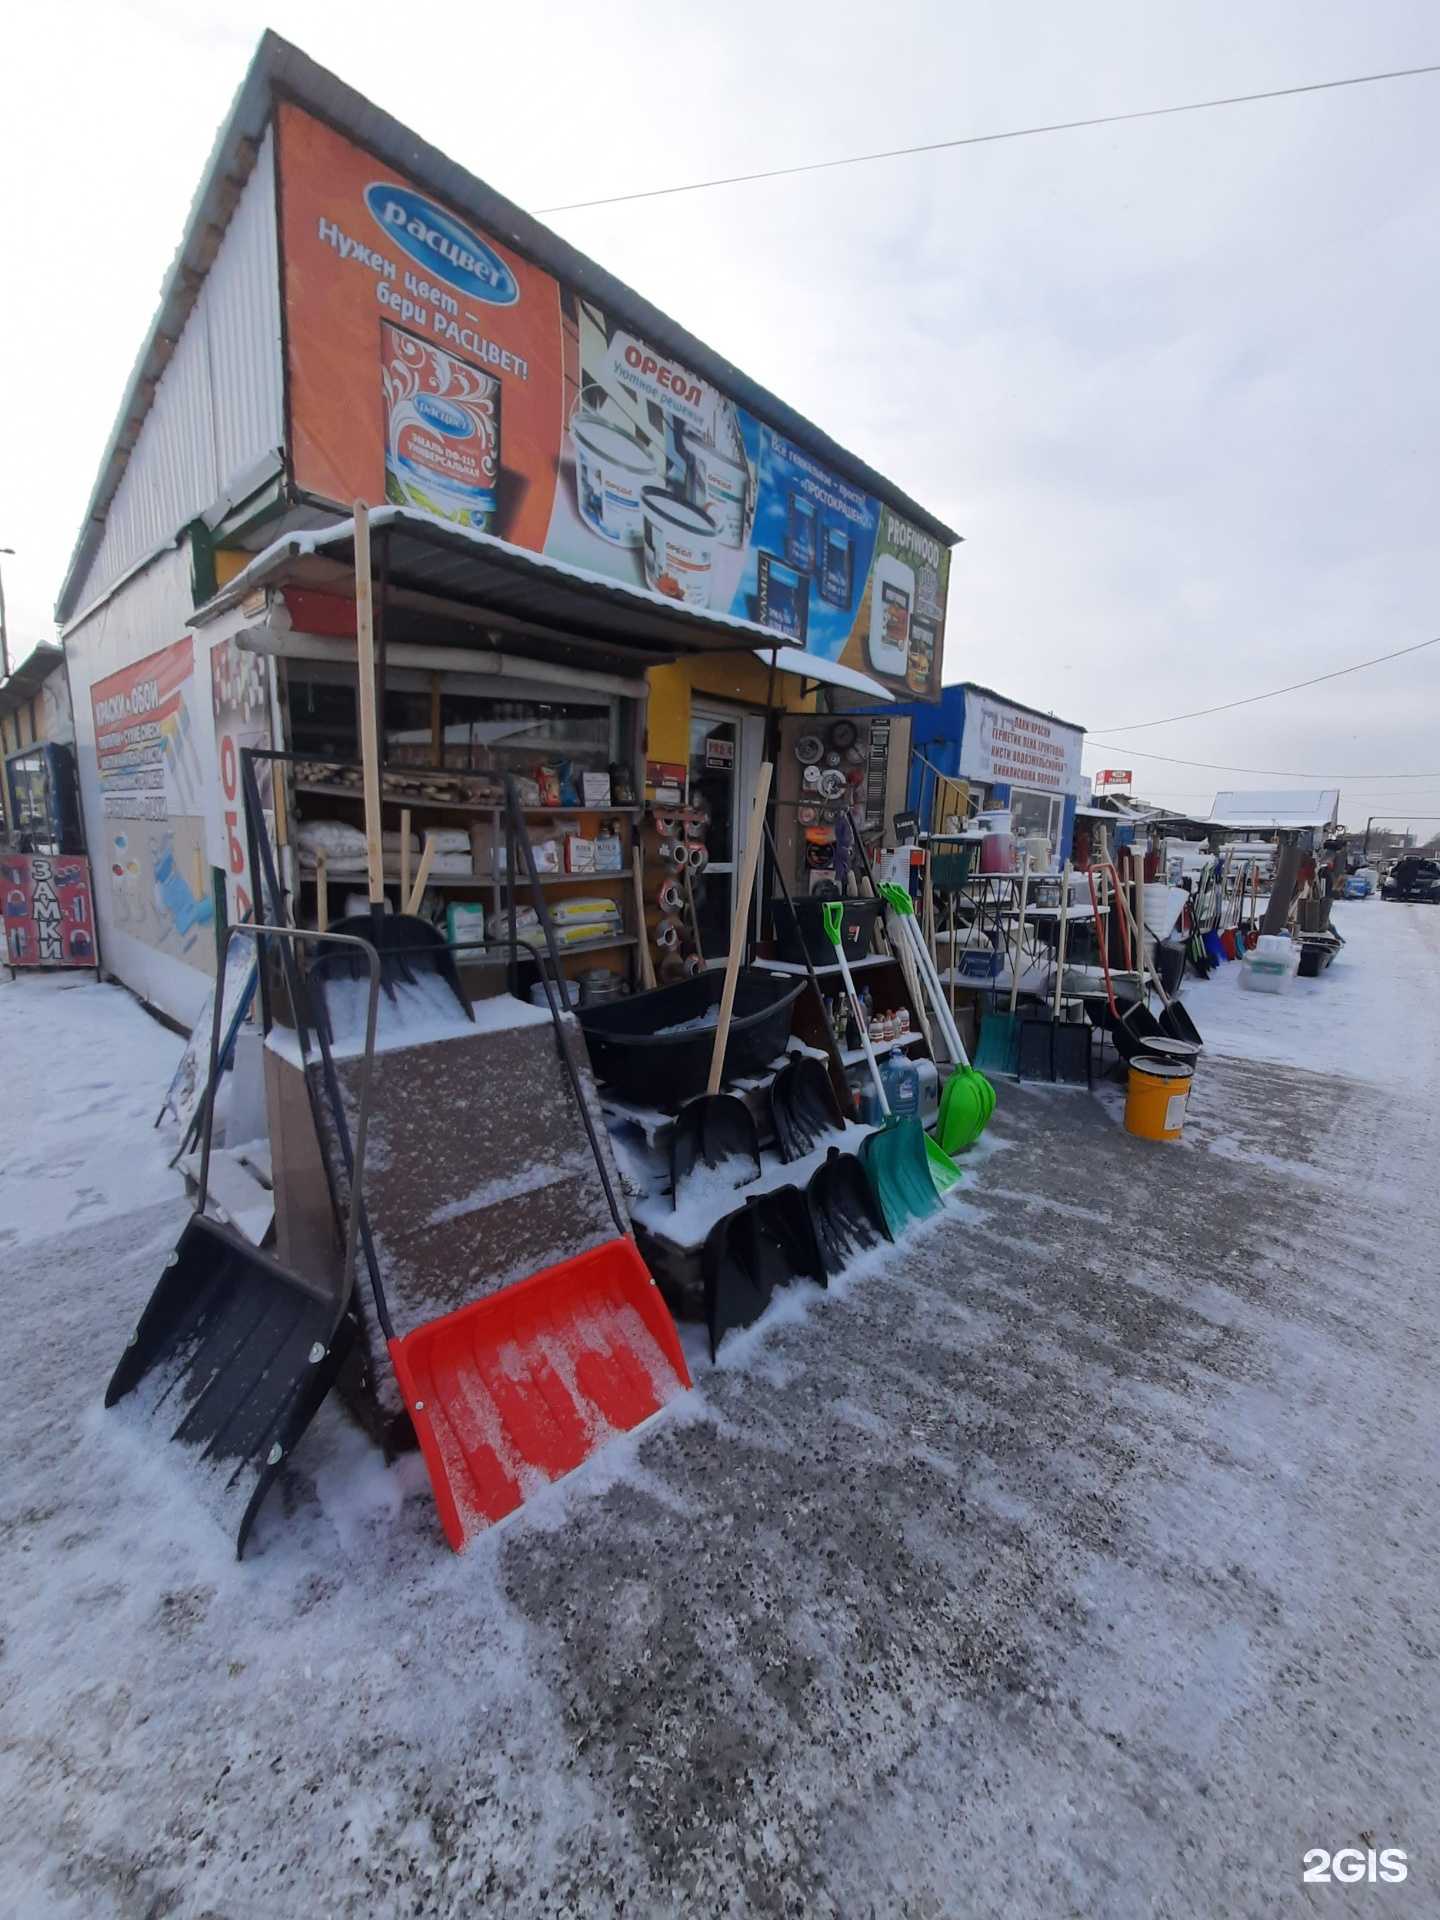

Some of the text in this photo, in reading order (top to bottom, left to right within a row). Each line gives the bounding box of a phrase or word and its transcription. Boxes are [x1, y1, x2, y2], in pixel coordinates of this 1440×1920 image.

[318, 217, 396, 281] Нужен
[404, 269, 458, 316] цвет
[376, 281, 528, 380] бери РАСЦВЕТ!
[614, 360, 658, 397] Уютное
[625, 345, 703, 407] ОРЕОЛ
[887, 516, 940, 569] PROFIWOOD
[131, 680, 160, 715] ОБОИ
[31, 859, 64, 960] ЗАМКИ
